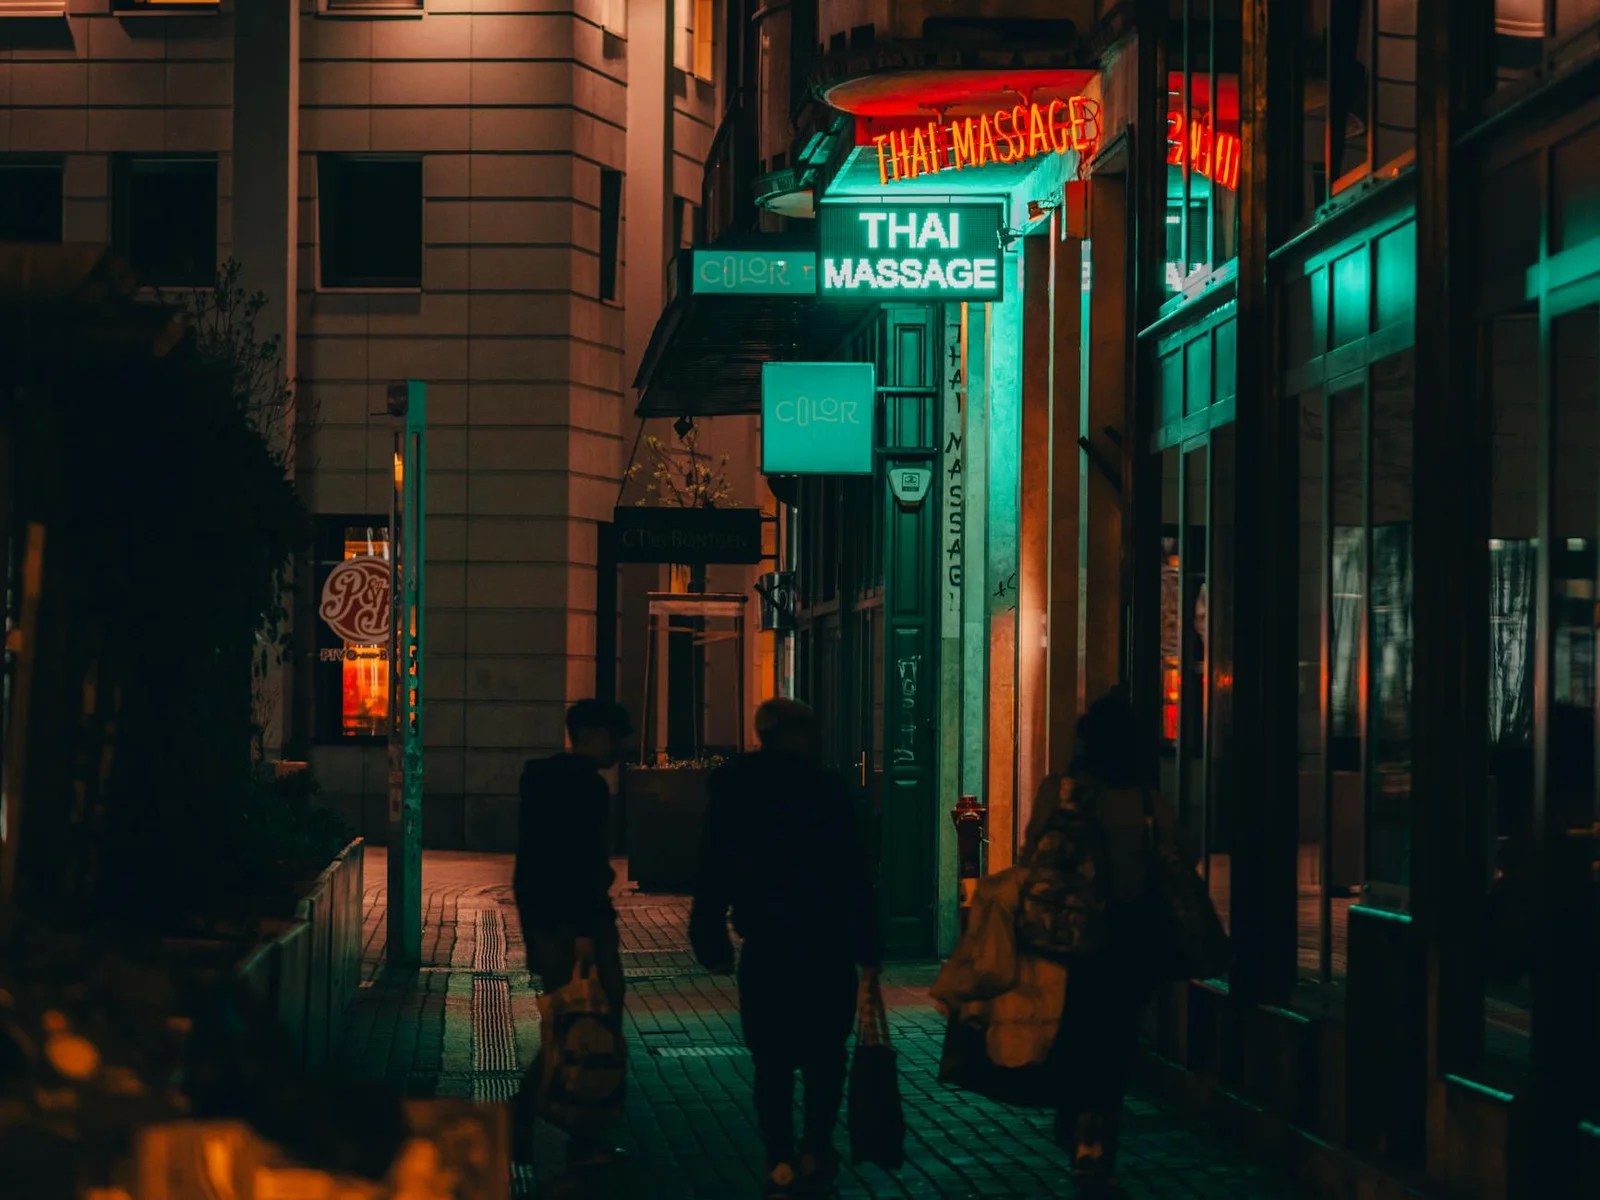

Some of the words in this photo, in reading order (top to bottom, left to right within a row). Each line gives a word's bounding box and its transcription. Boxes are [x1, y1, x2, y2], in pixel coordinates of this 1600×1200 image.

[873, 121, 940, 186] THAI
[951, 95, 1087, 170] MASSAGE
[859, 212, 960, 248] THAI
[700, 255, 790, 288] COLOR
[824, 258, 996, 289] MASSAGE
[775, 396, 860, 427] COLOR
